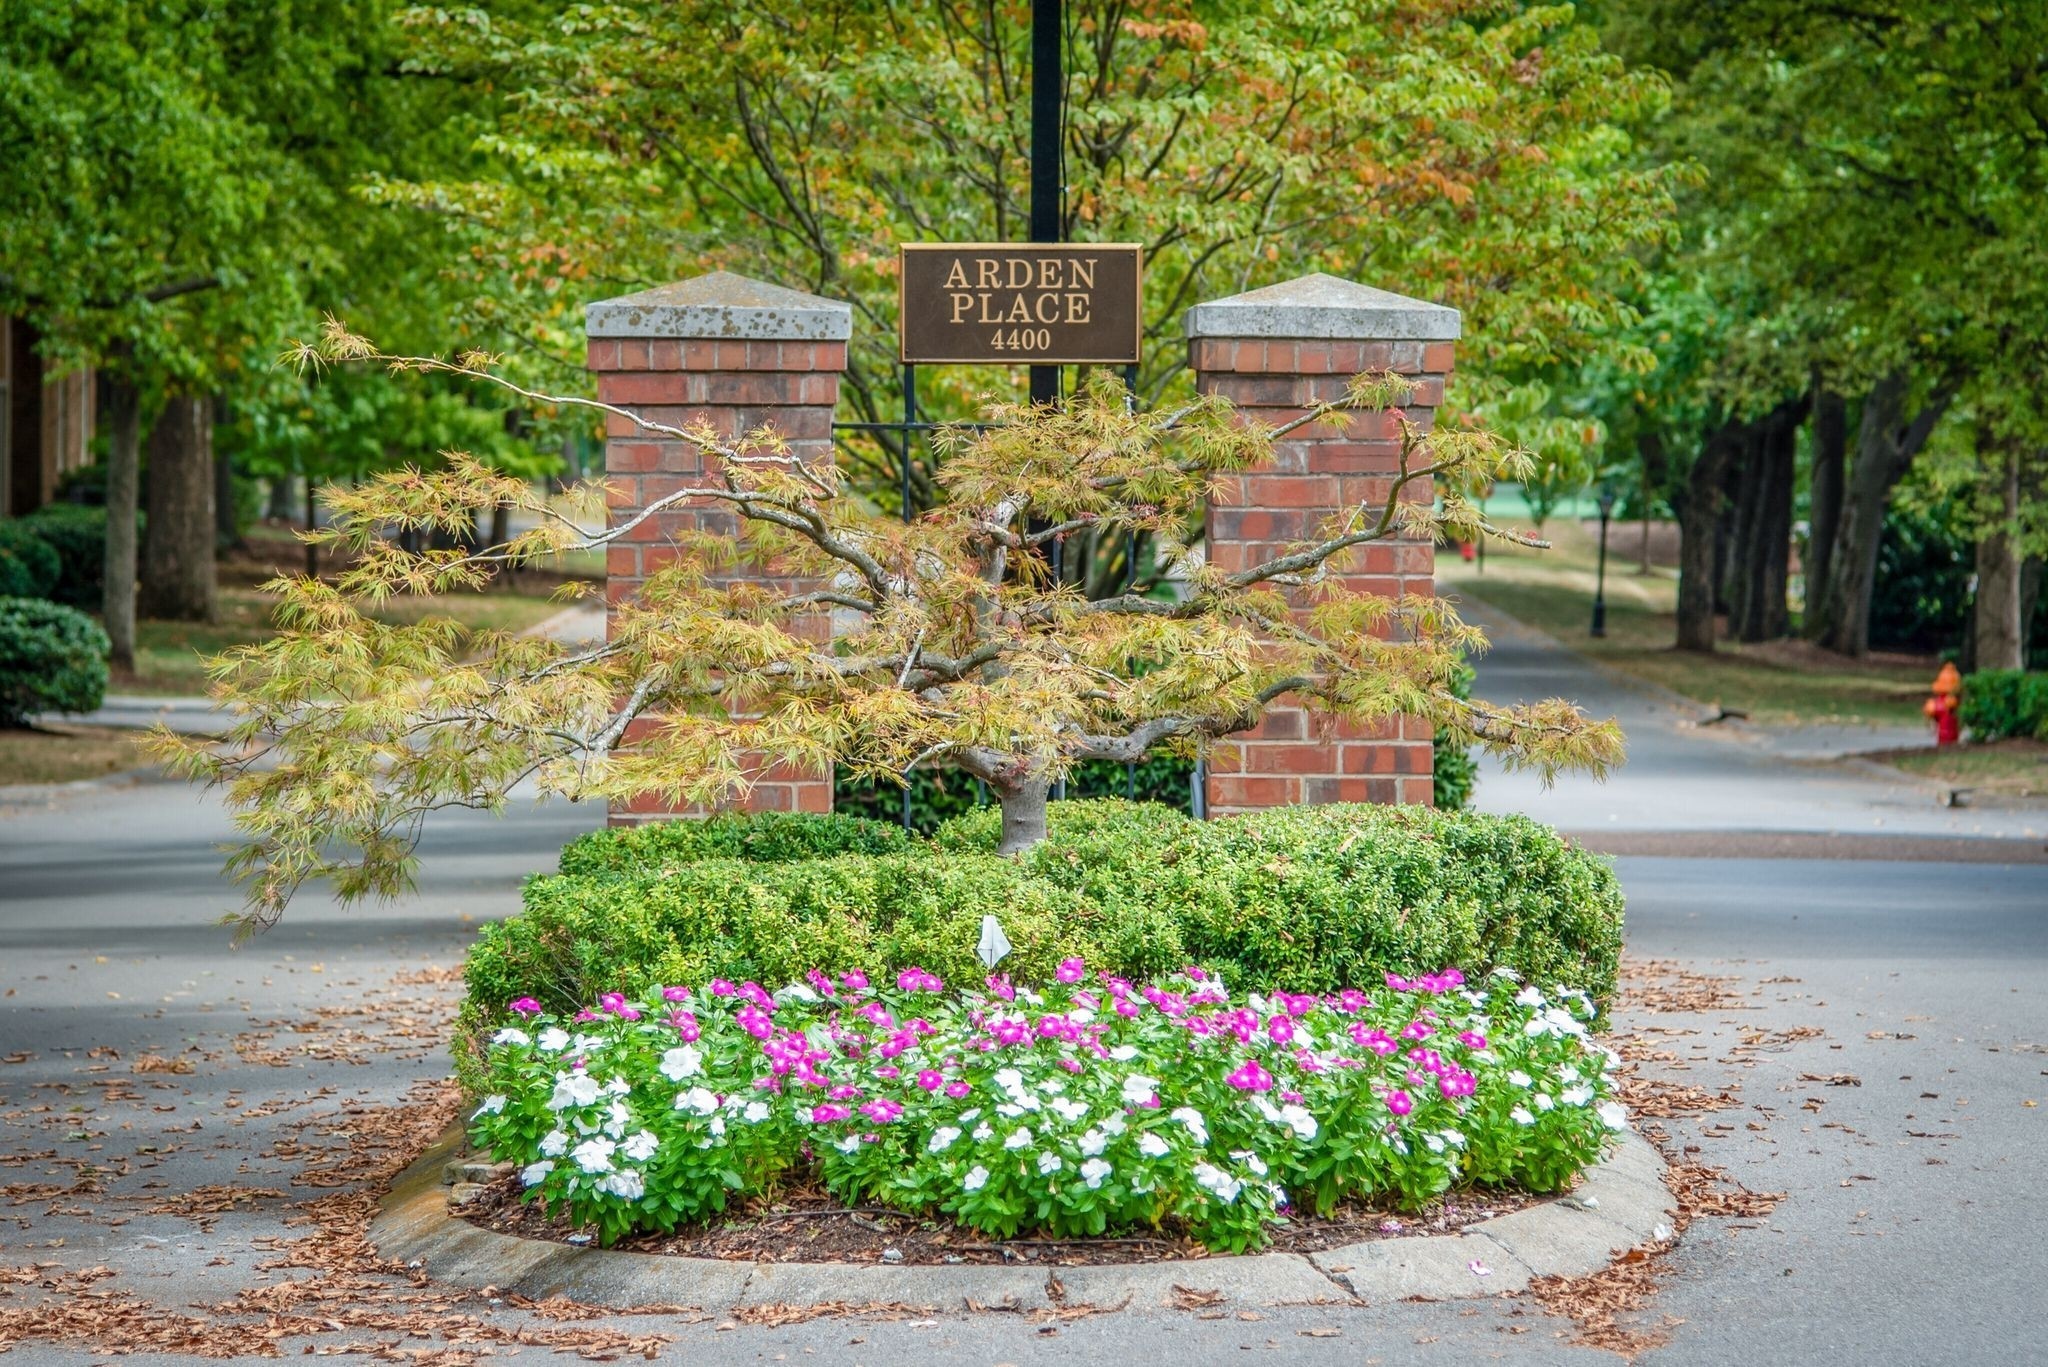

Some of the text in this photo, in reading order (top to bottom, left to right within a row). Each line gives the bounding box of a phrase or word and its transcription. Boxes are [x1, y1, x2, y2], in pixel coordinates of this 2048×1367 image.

[943, 259, 1097, 288] ARDEN
[950, 293, 1090, 323] PLACE
[991, 329, 1050, 350] 4400
